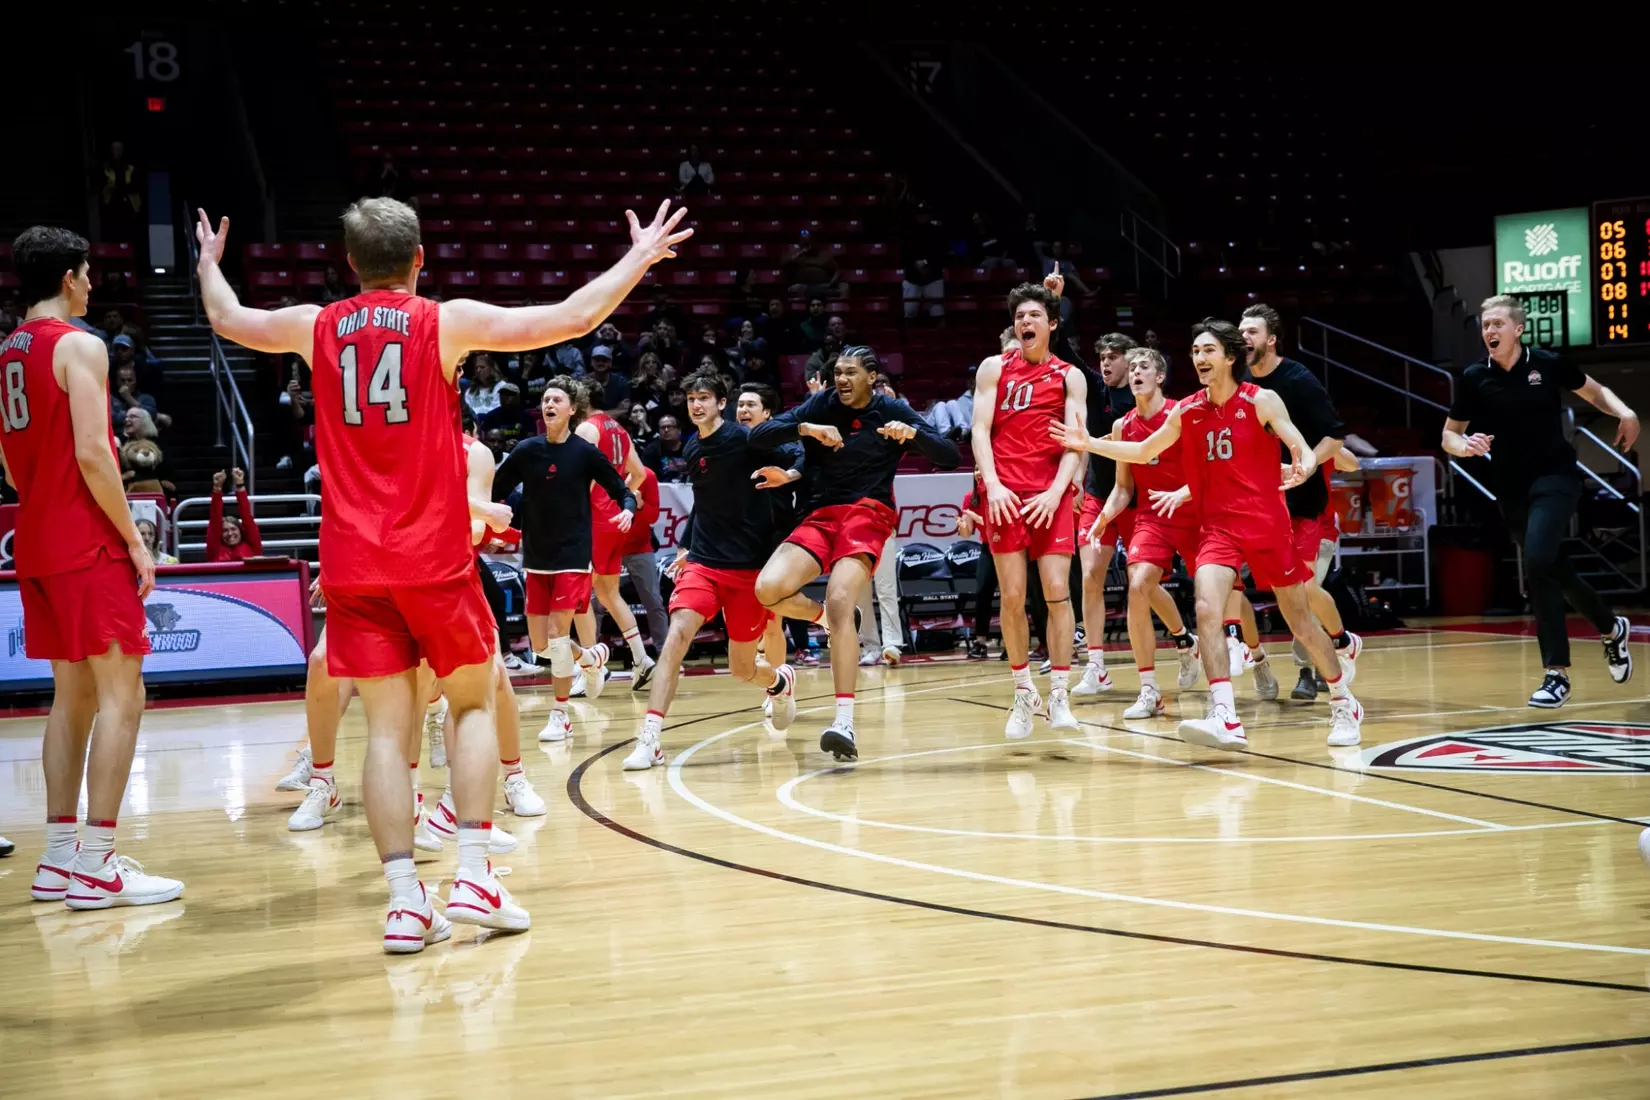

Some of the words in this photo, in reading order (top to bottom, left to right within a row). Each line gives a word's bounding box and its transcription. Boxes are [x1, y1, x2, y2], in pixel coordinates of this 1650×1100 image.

[123, 40, 181, 82] 18
[1600, 220, 1626, 240] 05
[1600, 241, 1627, 260] 06
[1503, 255, 1582, 284] Ruoff
[1600, 261, 1627, 280] 07
[1601, 282, 1628, 301] 08
[1608, 303, 1628, 319] 11
[337, 306, 369, 339] OHIO
[371, 305, 411, 337] STATE
[1608, 324, 1629, 340] 14
[338, 341, 411, 427] 14
[1000, 379, 1034, 412] 10
[611, 433, 624, 465] 11
[1206, 427, 1233, 461] 16
[1392, 477, 1409, 497] G
[1350, 494, 1361, 508] G
